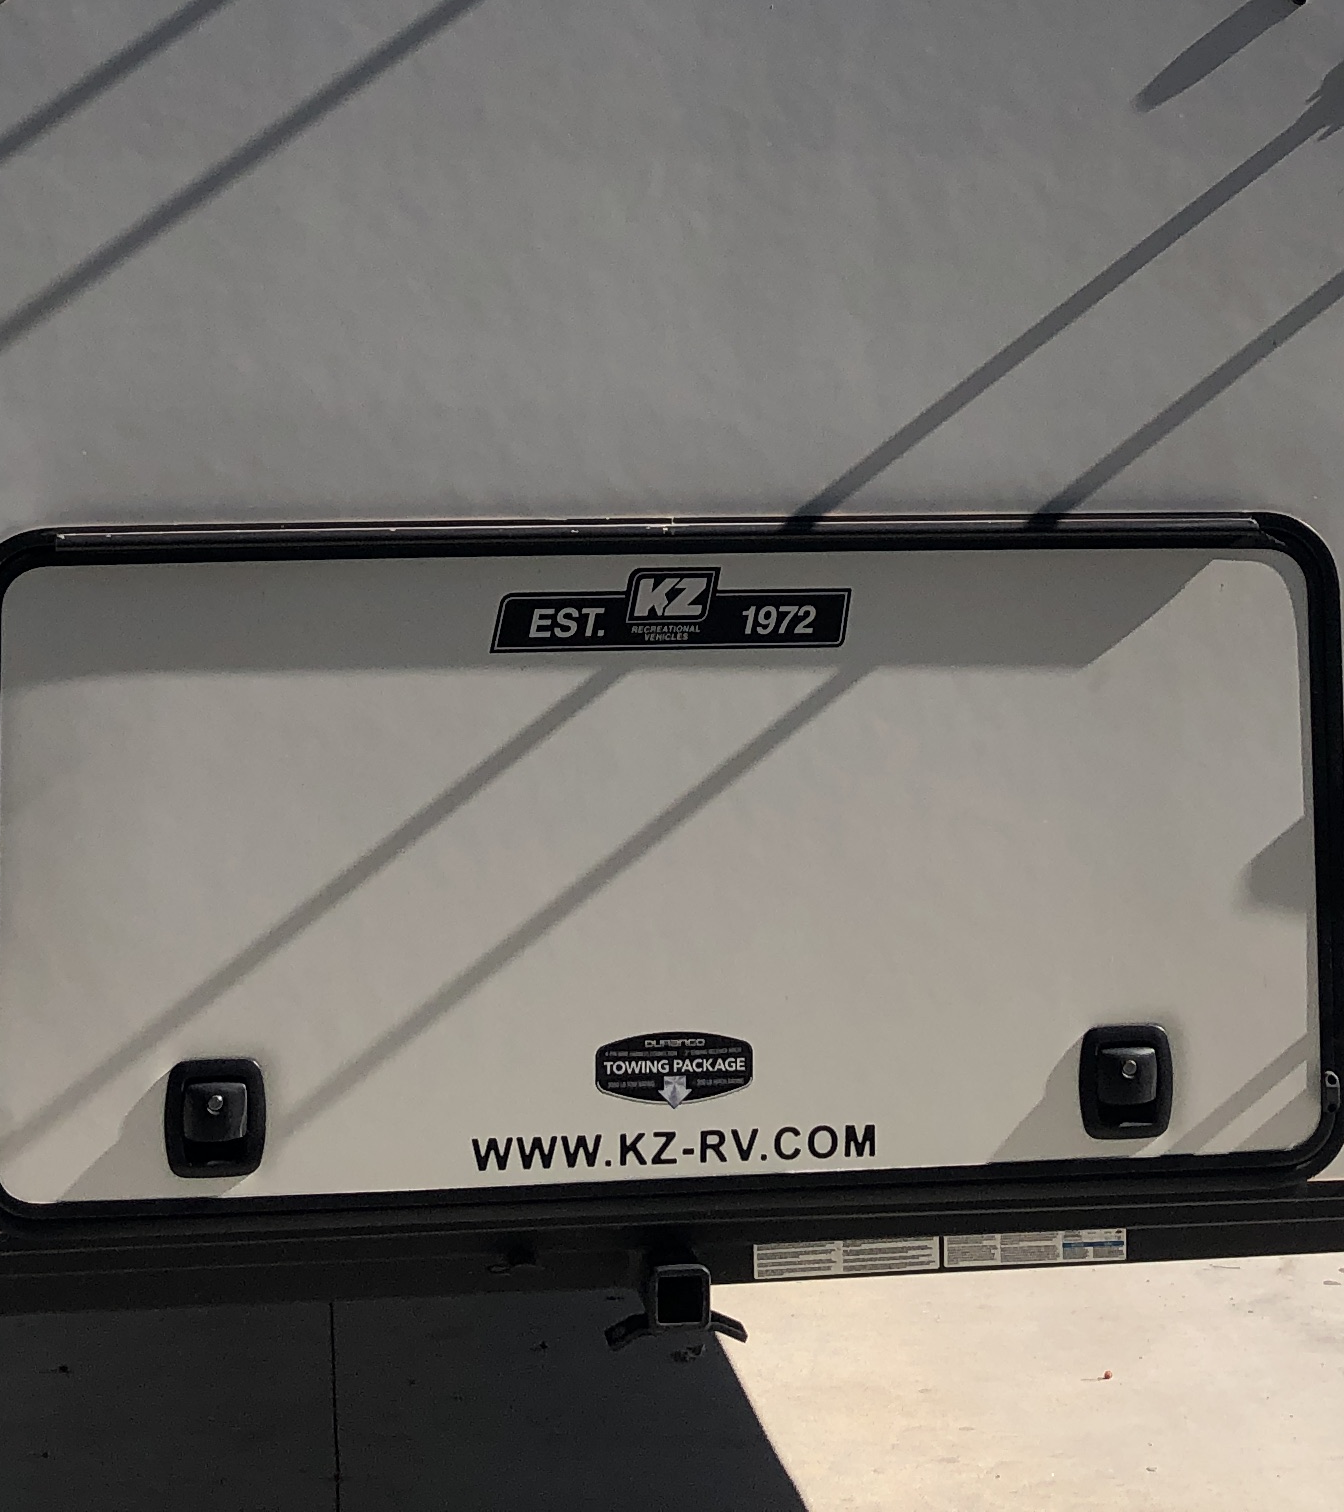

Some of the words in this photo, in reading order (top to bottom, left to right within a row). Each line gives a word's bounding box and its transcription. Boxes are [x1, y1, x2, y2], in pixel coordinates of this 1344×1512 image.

[634, 577, 708, 617] KZ
[529, 607, 605, 639] EST.
[742, 605, 817, 635] 1972
[631, 624, 701, 634] RECREATIONAL
[644, 633, 689, 642] VEHICLES
[604, 1059, 670, 1075] TOWING
[673, 1057, 746, 1073] PACKAGE
[472, 1124, 877, 1172] WWW.KZ-RV.COM
